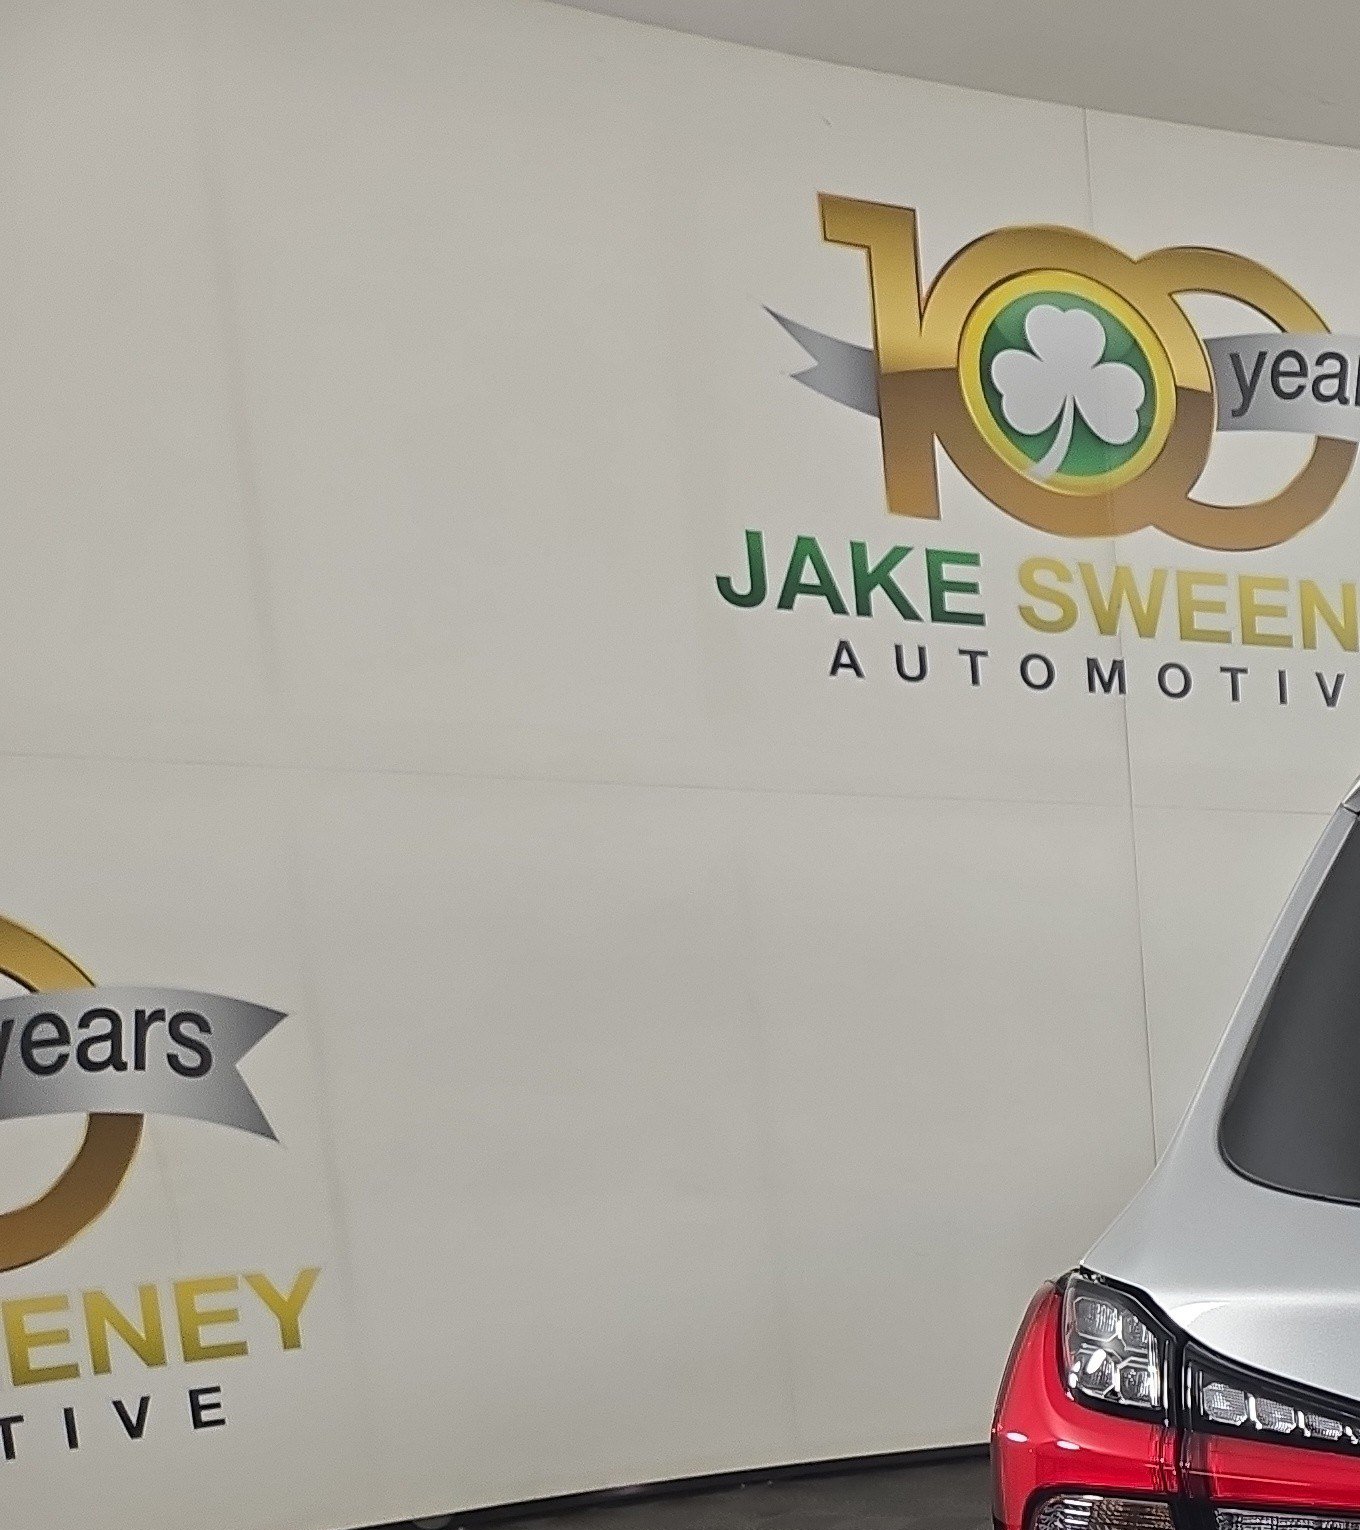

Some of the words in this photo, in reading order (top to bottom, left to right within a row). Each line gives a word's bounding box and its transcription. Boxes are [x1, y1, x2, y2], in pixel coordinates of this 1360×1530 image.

[817, 193, 1358, 552] 100
[715, 530, 987, 626] JAKE
[0, 1006, 214, 1080] ears
